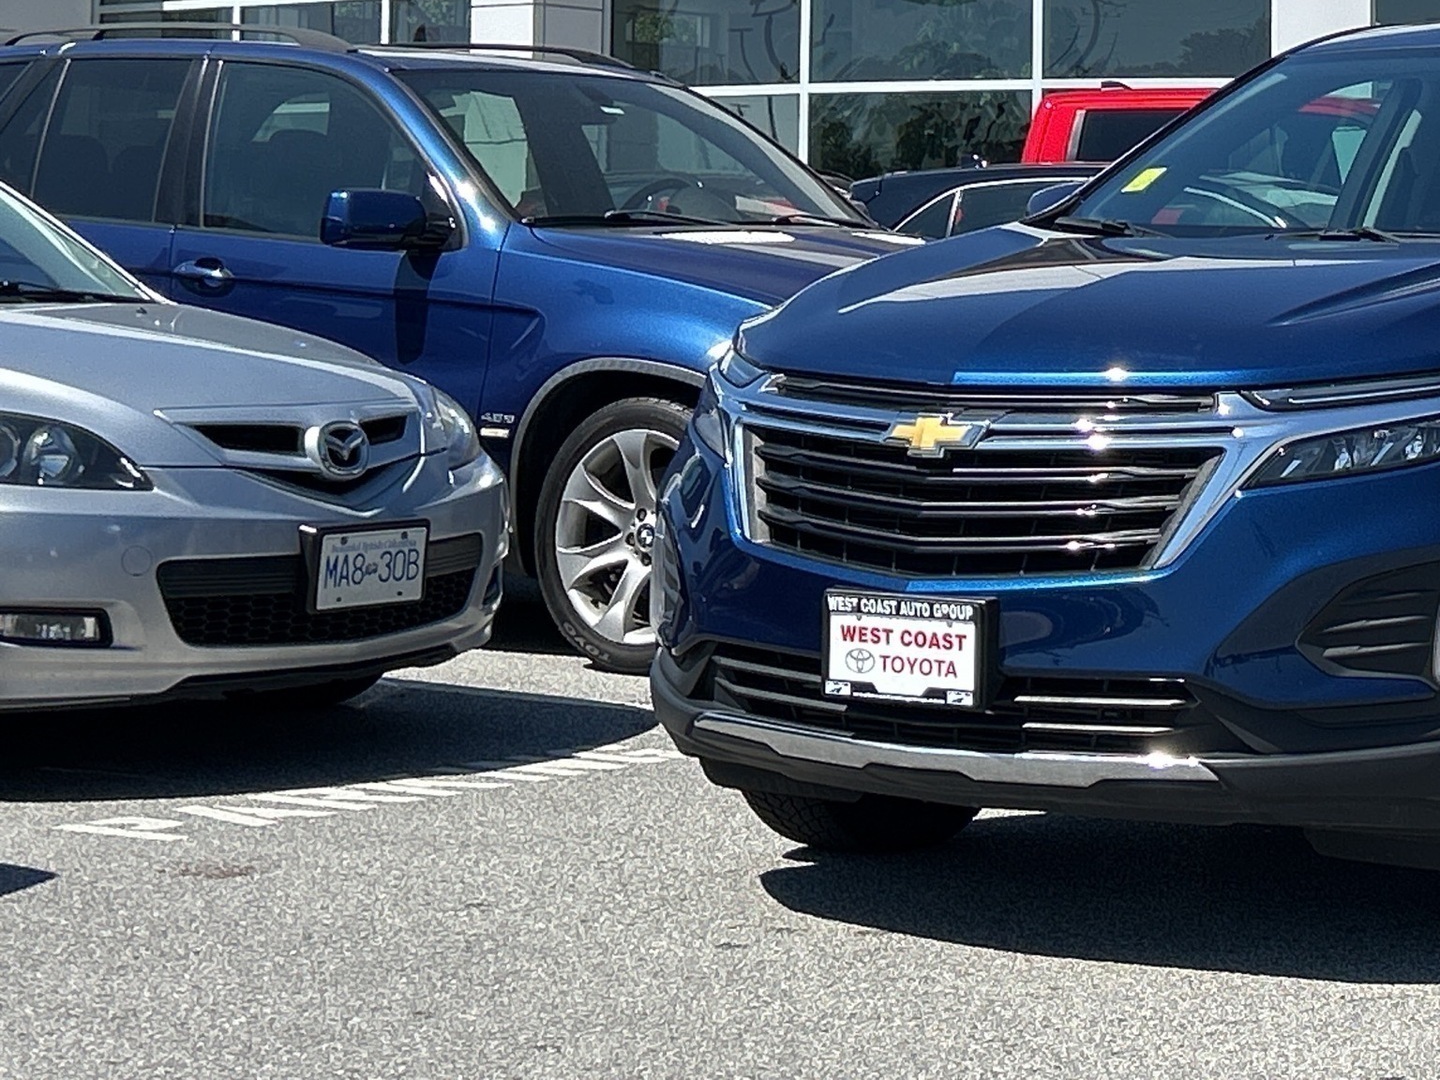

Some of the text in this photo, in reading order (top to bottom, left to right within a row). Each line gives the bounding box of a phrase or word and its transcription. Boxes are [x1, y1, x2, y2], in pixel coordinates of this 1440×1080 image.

[860, 597, 898, 615] COAST
[899, 600, 931, 618] AUTO
[840, 624, 967, 652] WEST COAST
[879, 654, 958, 679] TOYOTA
